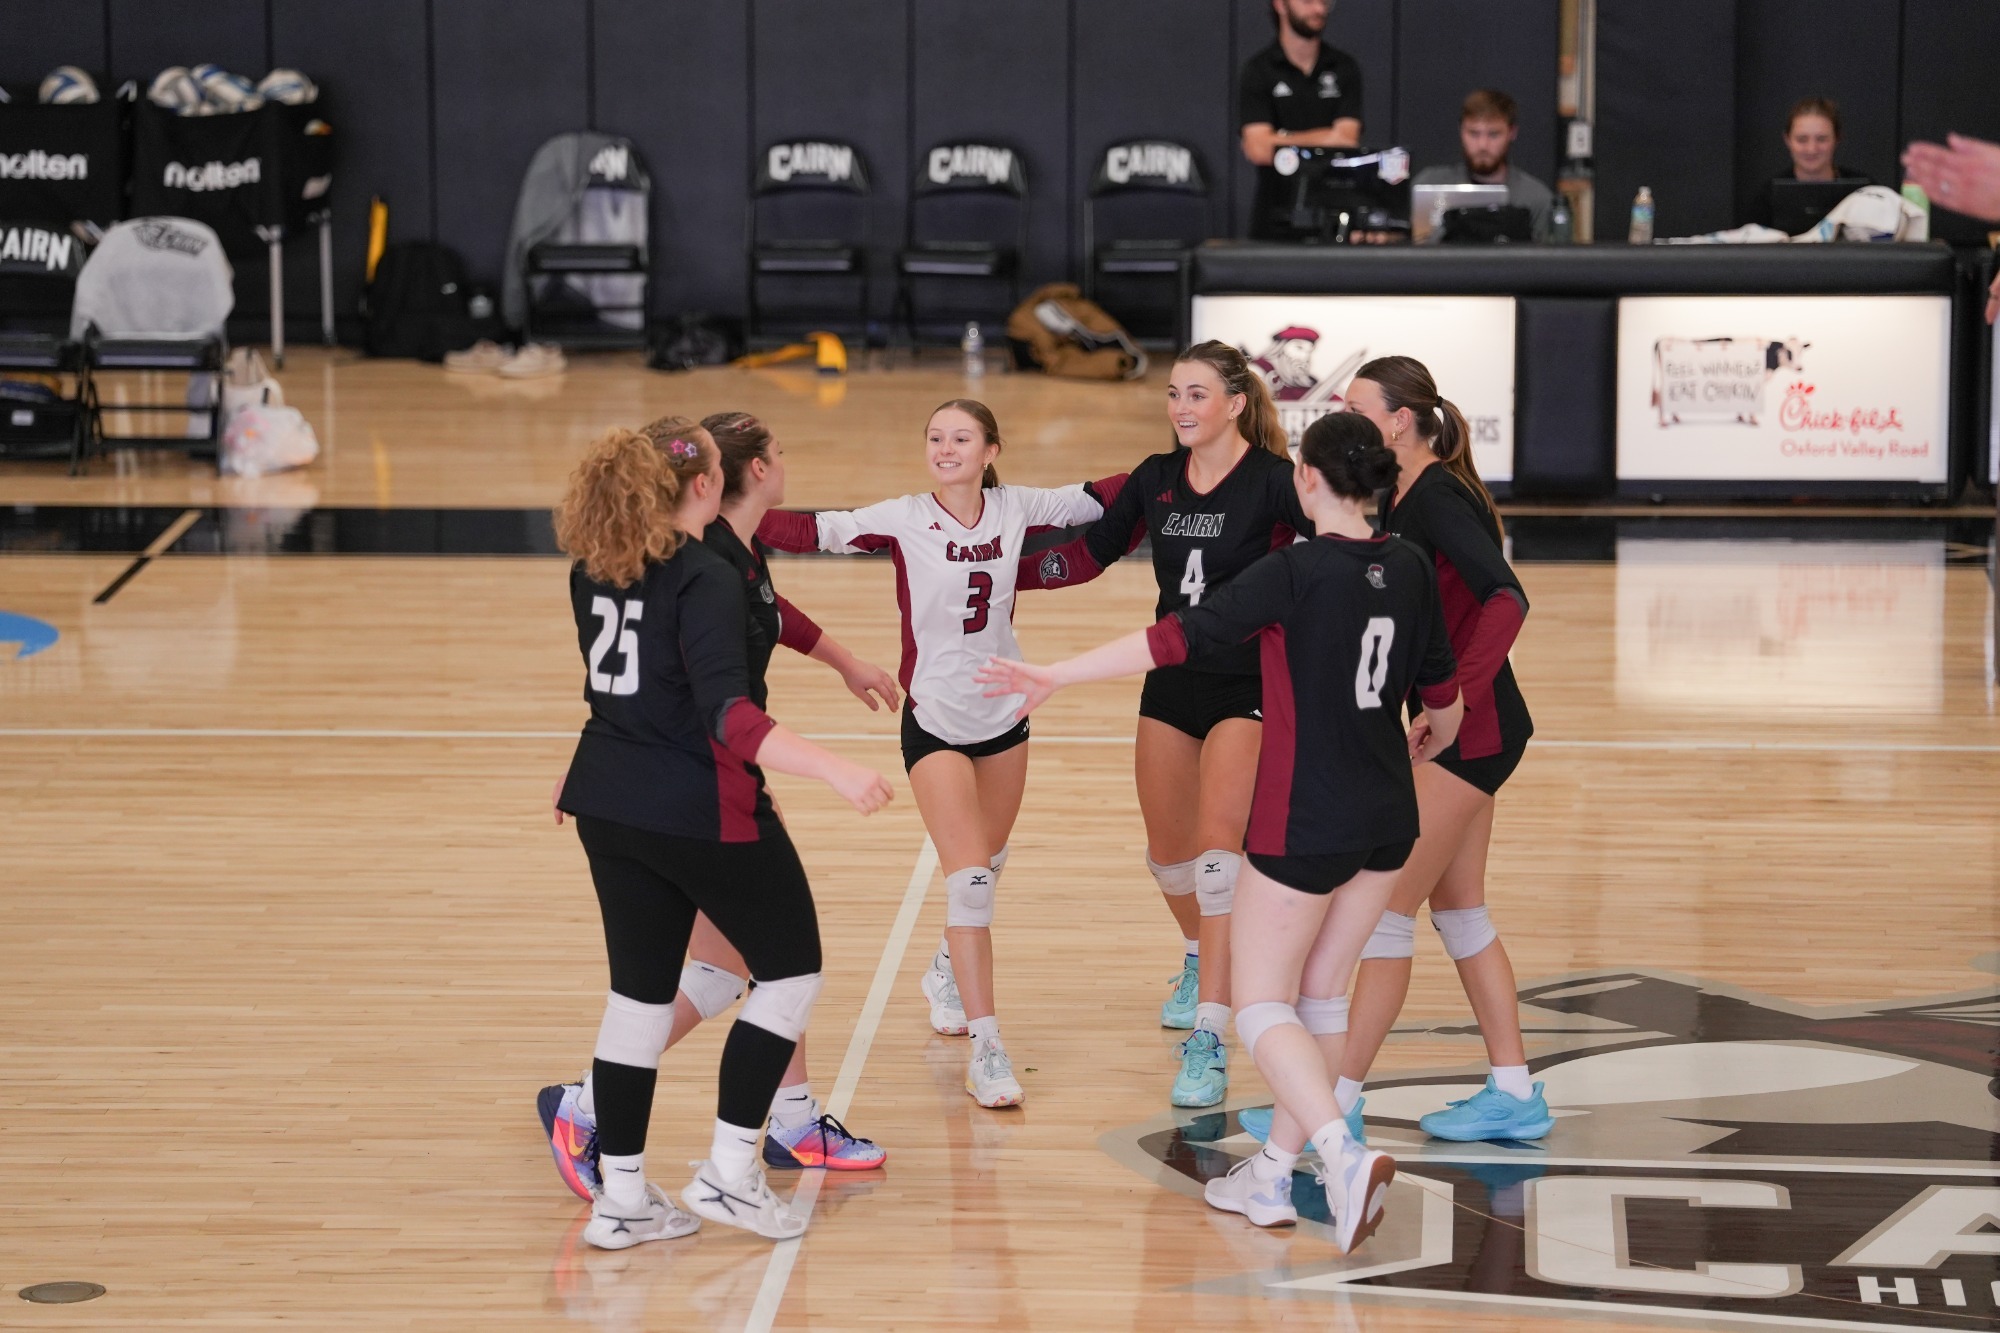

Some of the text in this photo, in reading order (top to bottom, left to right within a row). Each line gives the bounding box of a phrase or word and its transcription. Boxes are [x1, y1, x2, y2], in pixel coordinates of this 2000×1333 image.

[768, 142, 853, 182] CAIRN
[928, 145, 1012, 184] CAIRN
[1106, 145, 1191, 184] CAIRN
[0, 227, 73, 271] AIRN
[1780, 438, 1930, 460] Oxford Valley Road
[1161, 512, 1225, 537] CAIRN
[945, 535, 1004, 562] CAIRN
[1180, 548, 1206, 607] 4
[963, 571, 993, 635] 3
[589, 595, 644, 696] 25
[1355, 616, 1395, 710] 0
[1857, 1275, 2000, 1306] HI
